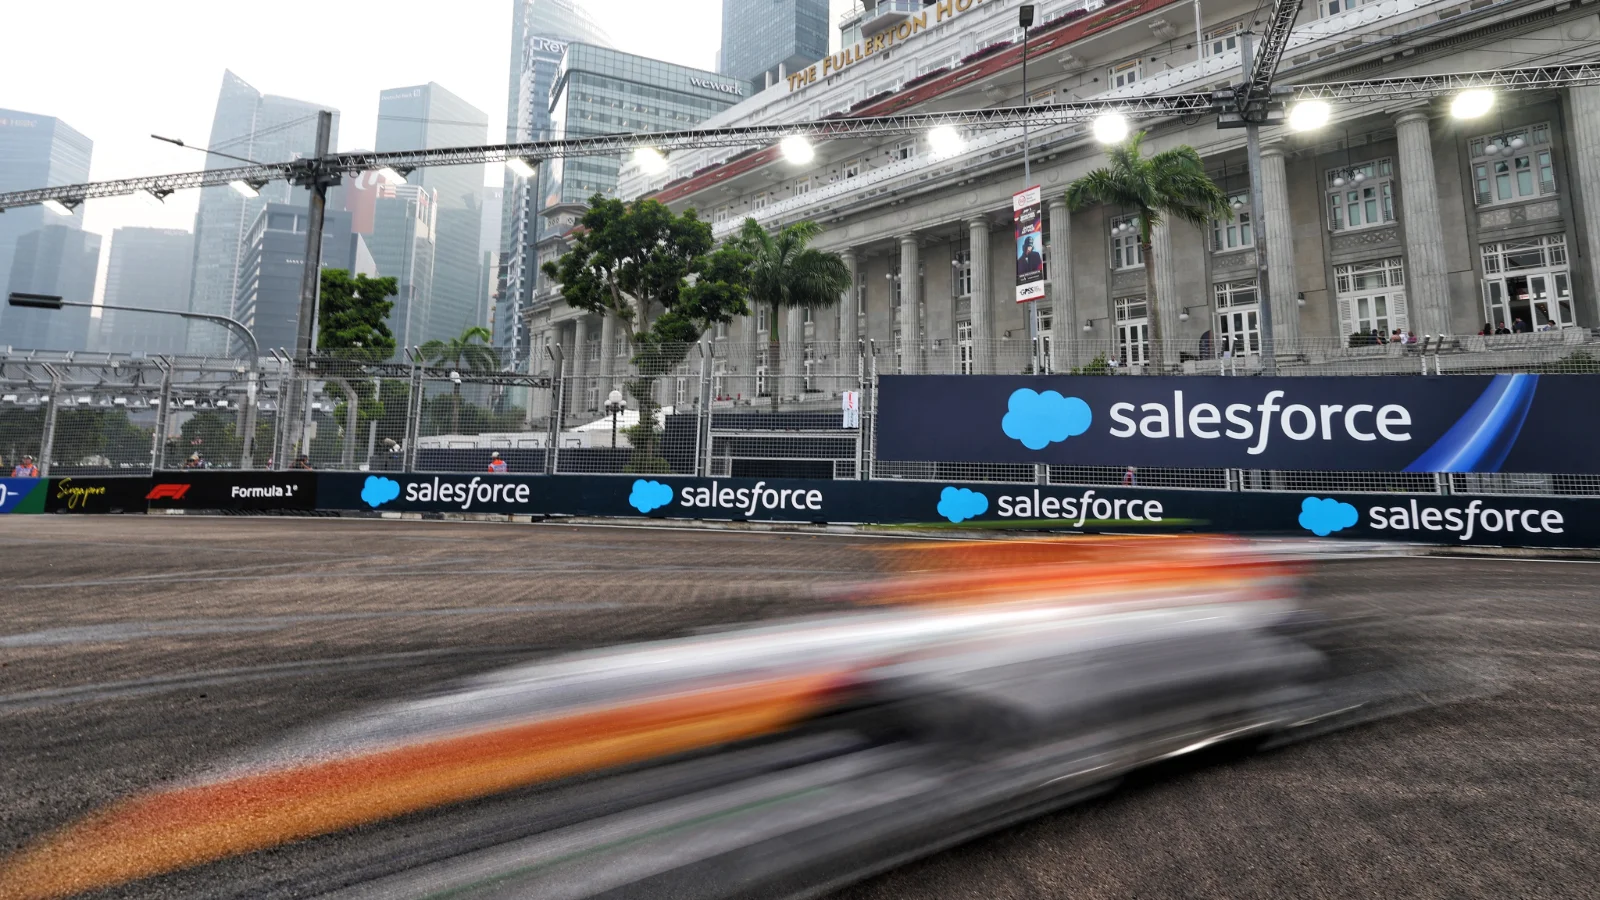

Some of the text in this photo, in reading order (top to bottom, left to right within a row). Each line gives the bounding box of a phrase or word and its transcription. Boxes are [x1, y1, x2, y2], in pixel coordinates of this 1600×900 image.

[787, 65, 817, 92] THE
[822, 11, 928, 76] FULLERTON
[690, 75, 744, 96] wework
[1109, 390, 1412, 455] salesforce
[57, 477, 106, 509] Singapore
[231, 485, 283, 498] Formula
[405, 476, 530, 510] salesforce
[680, 480, 823, 516] salesforce
[997, 489, 1164, 527] salesforce
[1369, 500, 1564, 541] salesforce
